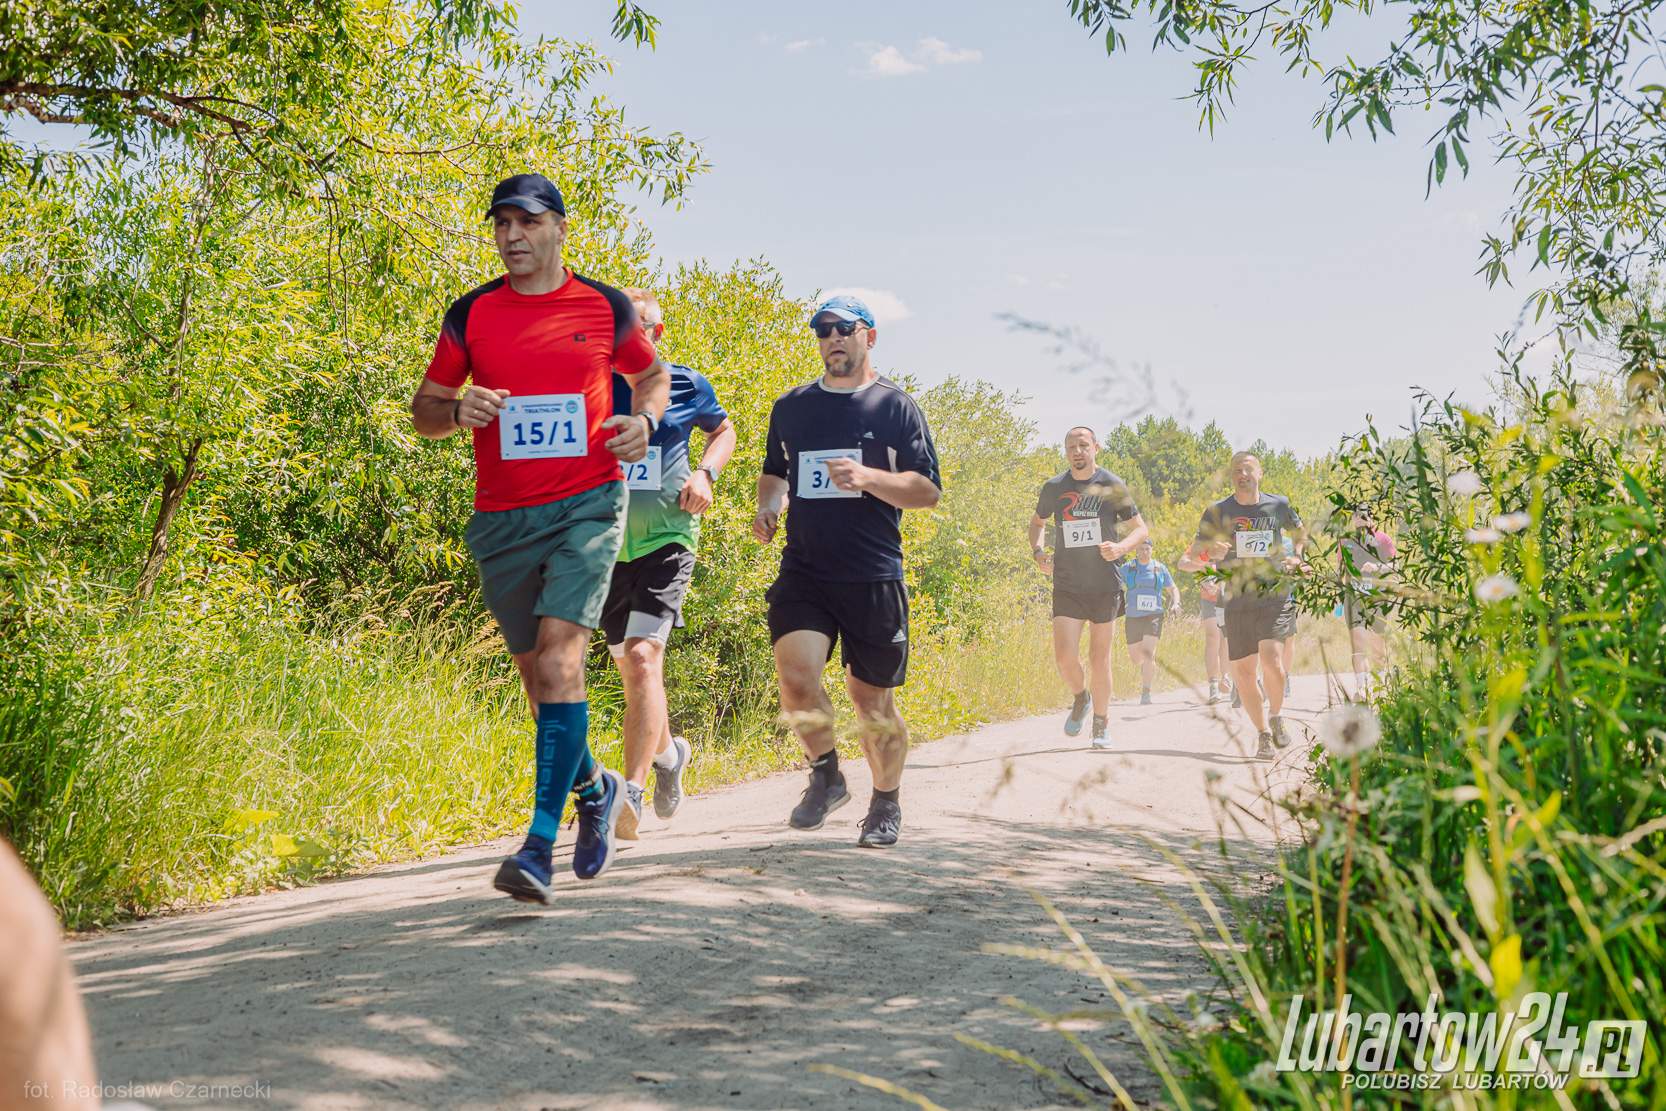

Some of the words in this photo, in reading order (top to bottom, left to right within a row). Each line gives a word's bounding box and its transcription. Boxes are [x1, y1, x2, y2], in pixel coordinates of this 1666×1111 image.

[513, 420, 577, 446] 15/1
[620, 463, 648, 482] /2
[812, 470, 831, 489] 3/
[1072, 530, 1094, 542] 9/1
